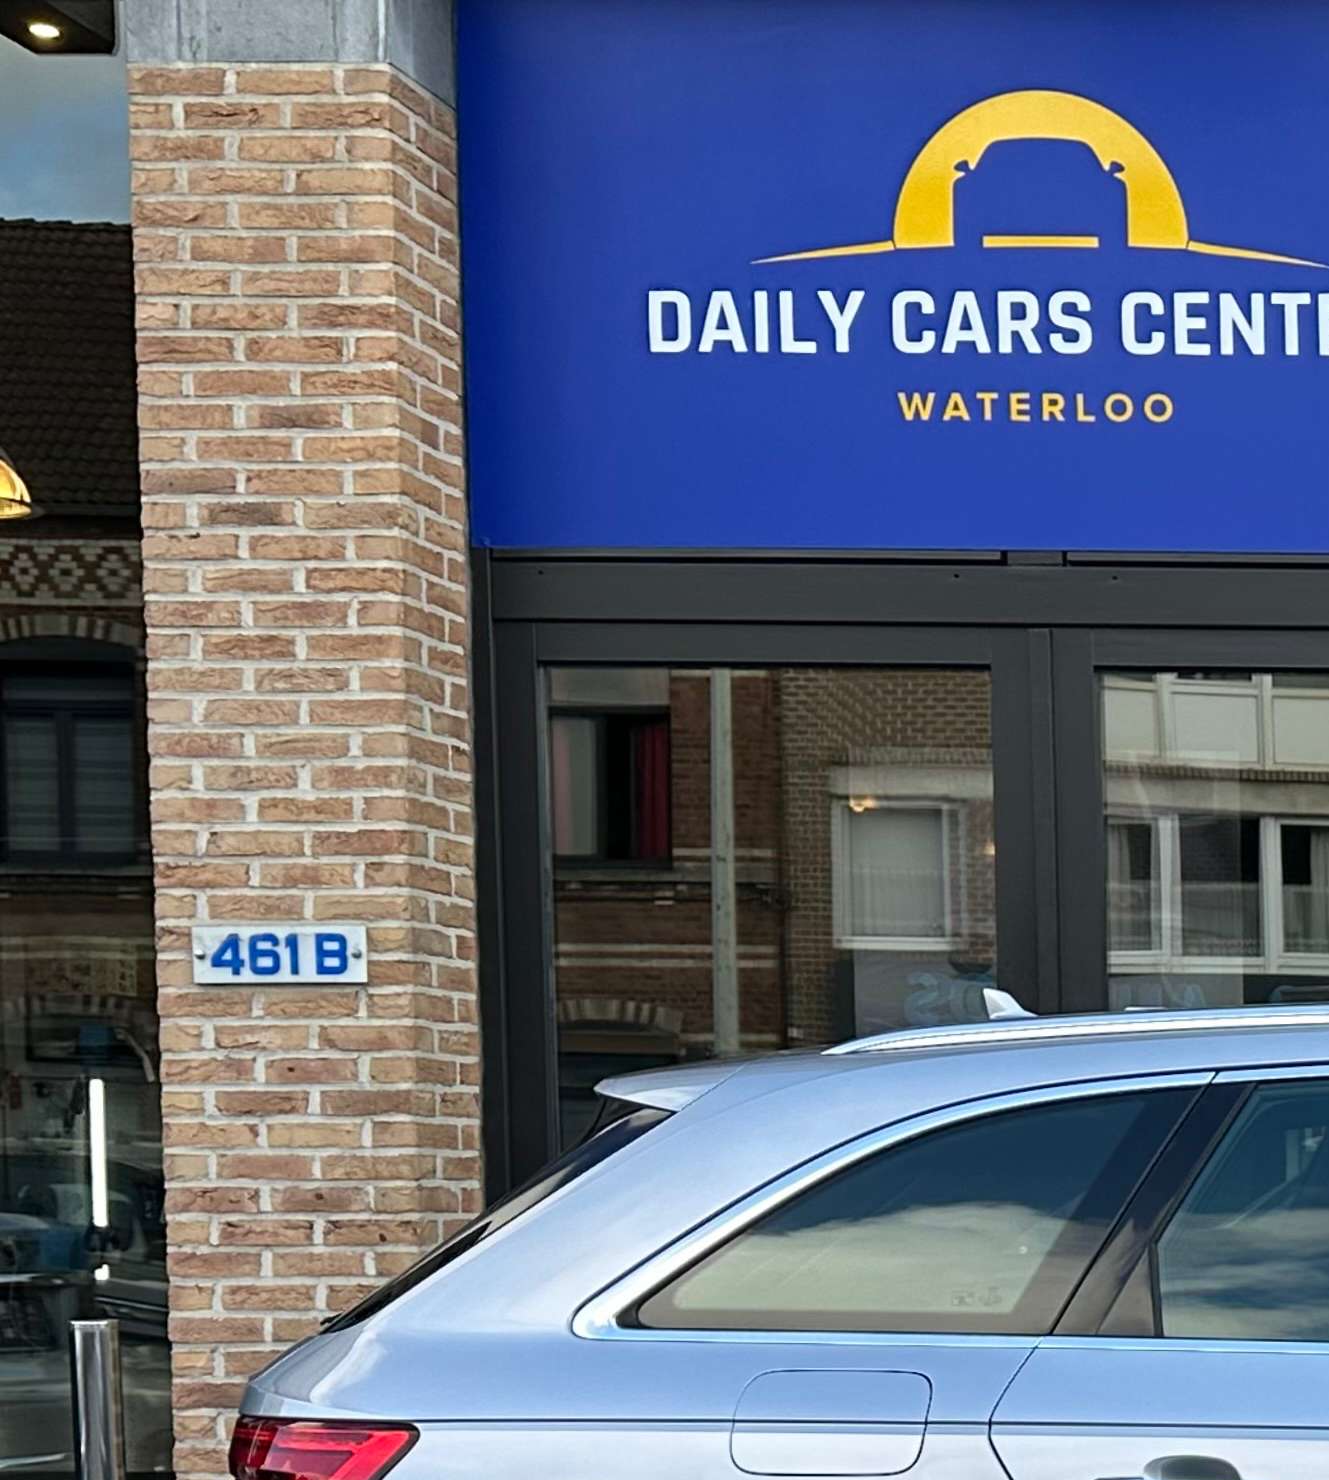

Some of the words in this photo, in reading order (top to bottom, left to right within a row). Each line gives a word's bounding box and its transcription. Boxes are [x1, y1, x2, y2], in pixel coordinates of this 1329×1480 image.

[648, 290, 865, 354] DAILY
[892, 290, 1093, 355] CARS
[897, 391, 1174, 423] WATERLOO
[210, 932, 301, 977] 461
[314, 932, 349, 977] B
